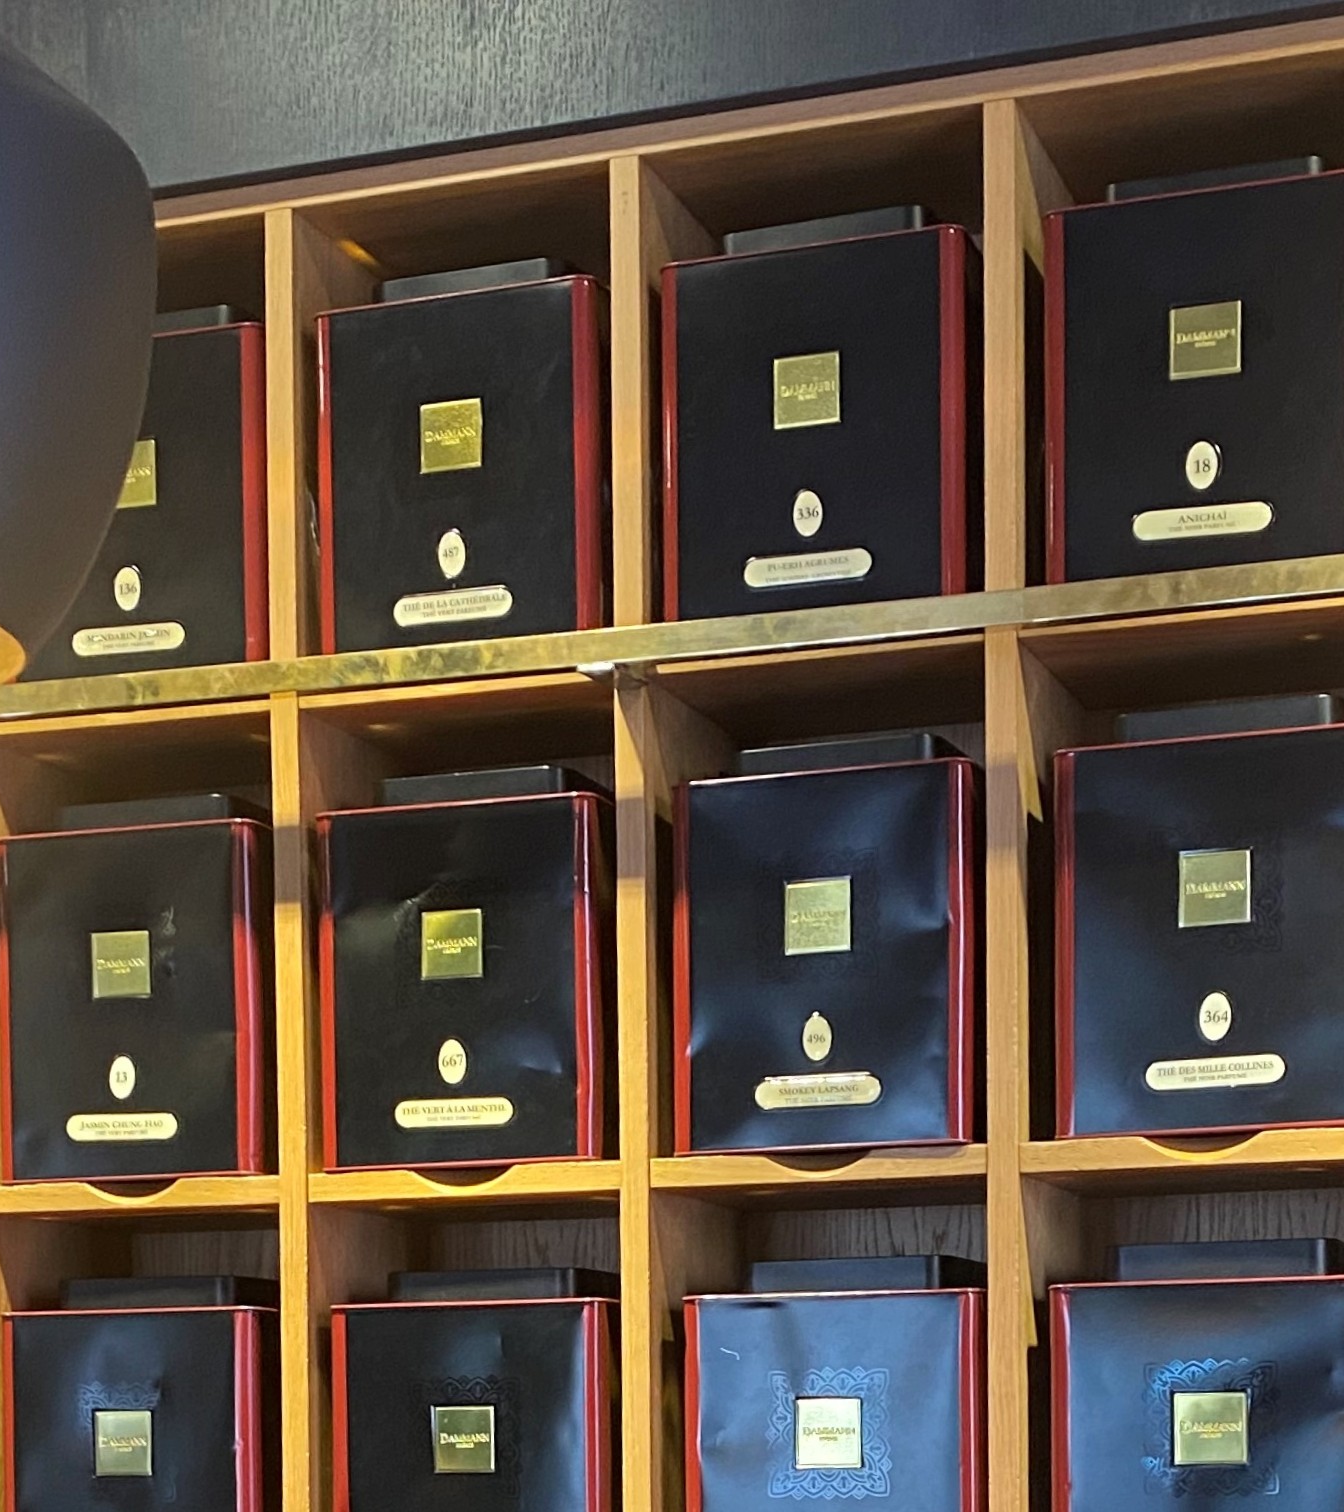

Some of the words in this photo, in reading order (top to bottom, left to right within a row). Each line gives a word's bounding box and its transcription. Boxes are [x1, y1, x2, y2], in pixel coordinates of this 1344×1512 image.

[1196, 458, 1211, 473] 18
[798, 507, 819, 520] 336
[804, 556, 849, 568] AGRUMES
[120, 584, 138, 595] 136
[423, 600, 434, 609] DE
[1204, 1011, 1228, 1023] 364
[807, 1033, 826, 1044] 496
[442, 1054, 463, 1067] 667
[1156, 1067, 1177, 1077] THÉ
[1178, 1065, 1197, 1075] DES
[1197, 1063, 1227, 1074] MILLE
[1228, 1061, 1274, 1072] COLLINES
[778, 1086, 816, 1095] SMOKEY
[817, 1084, 859, 1094] LAPSANG
[422, 1104, 445, 1115] VERT
[453, 1104, 466, 1113] LA
[466, 1103, 506, 1112] MENTHE
[79, 1121, 111, 1131] JASMIN
[112, 1120, 143, 1129] CHUNG
[144, 1120, 164, 1128] HAO
